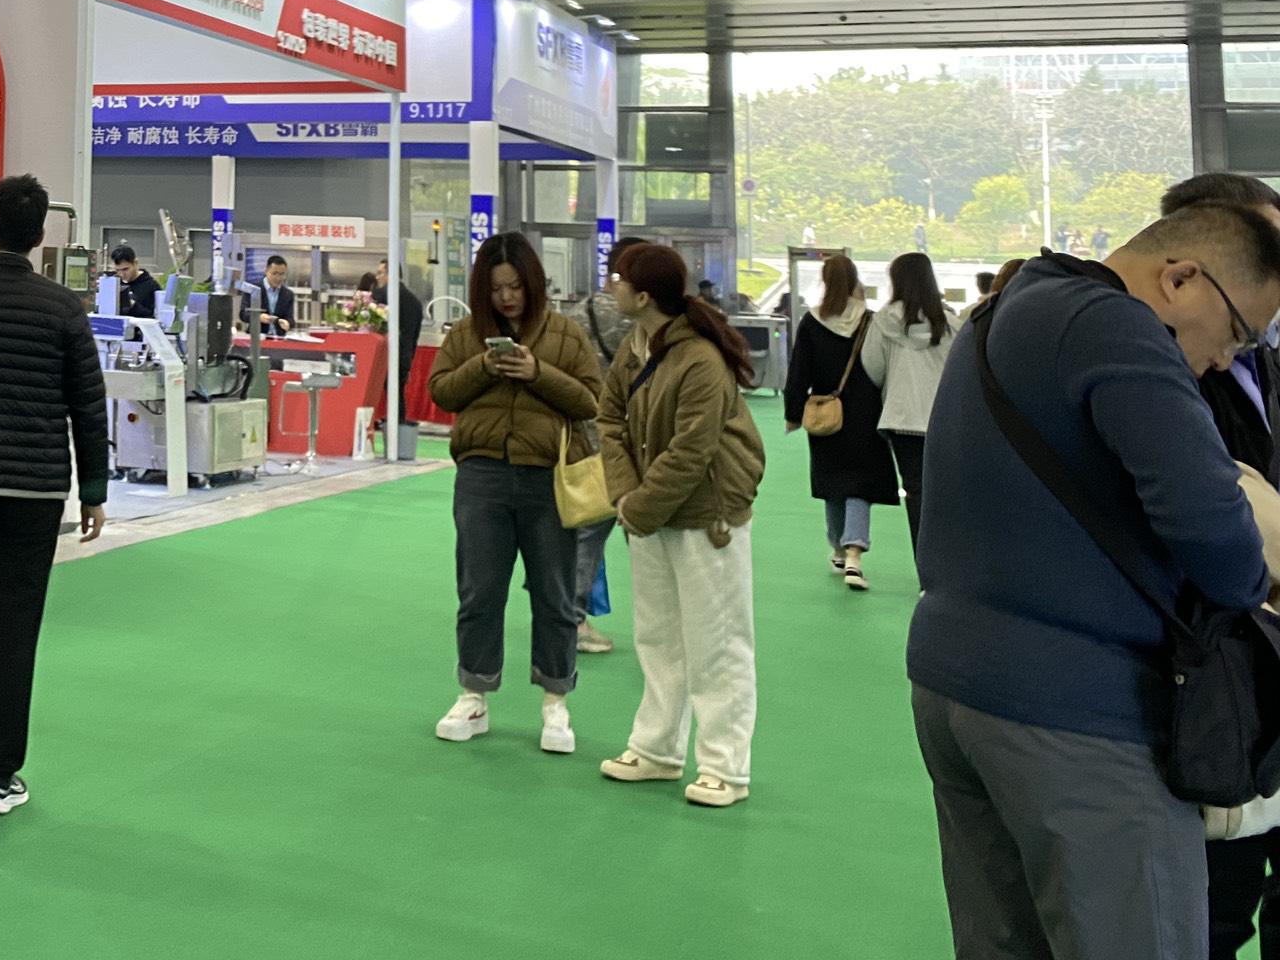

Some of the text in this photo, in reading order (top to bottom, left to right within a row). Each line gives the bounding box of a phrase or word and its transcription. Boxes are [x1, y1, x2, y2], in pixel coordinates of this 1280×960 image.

[408, 102, 467, 120] 9.1J17
[127, 126, 180, 145] 耐腐蚀
[185, 125, 239, 146] 长寿命
[277, 223, 358, 240] 陶瓷泵灌装机
